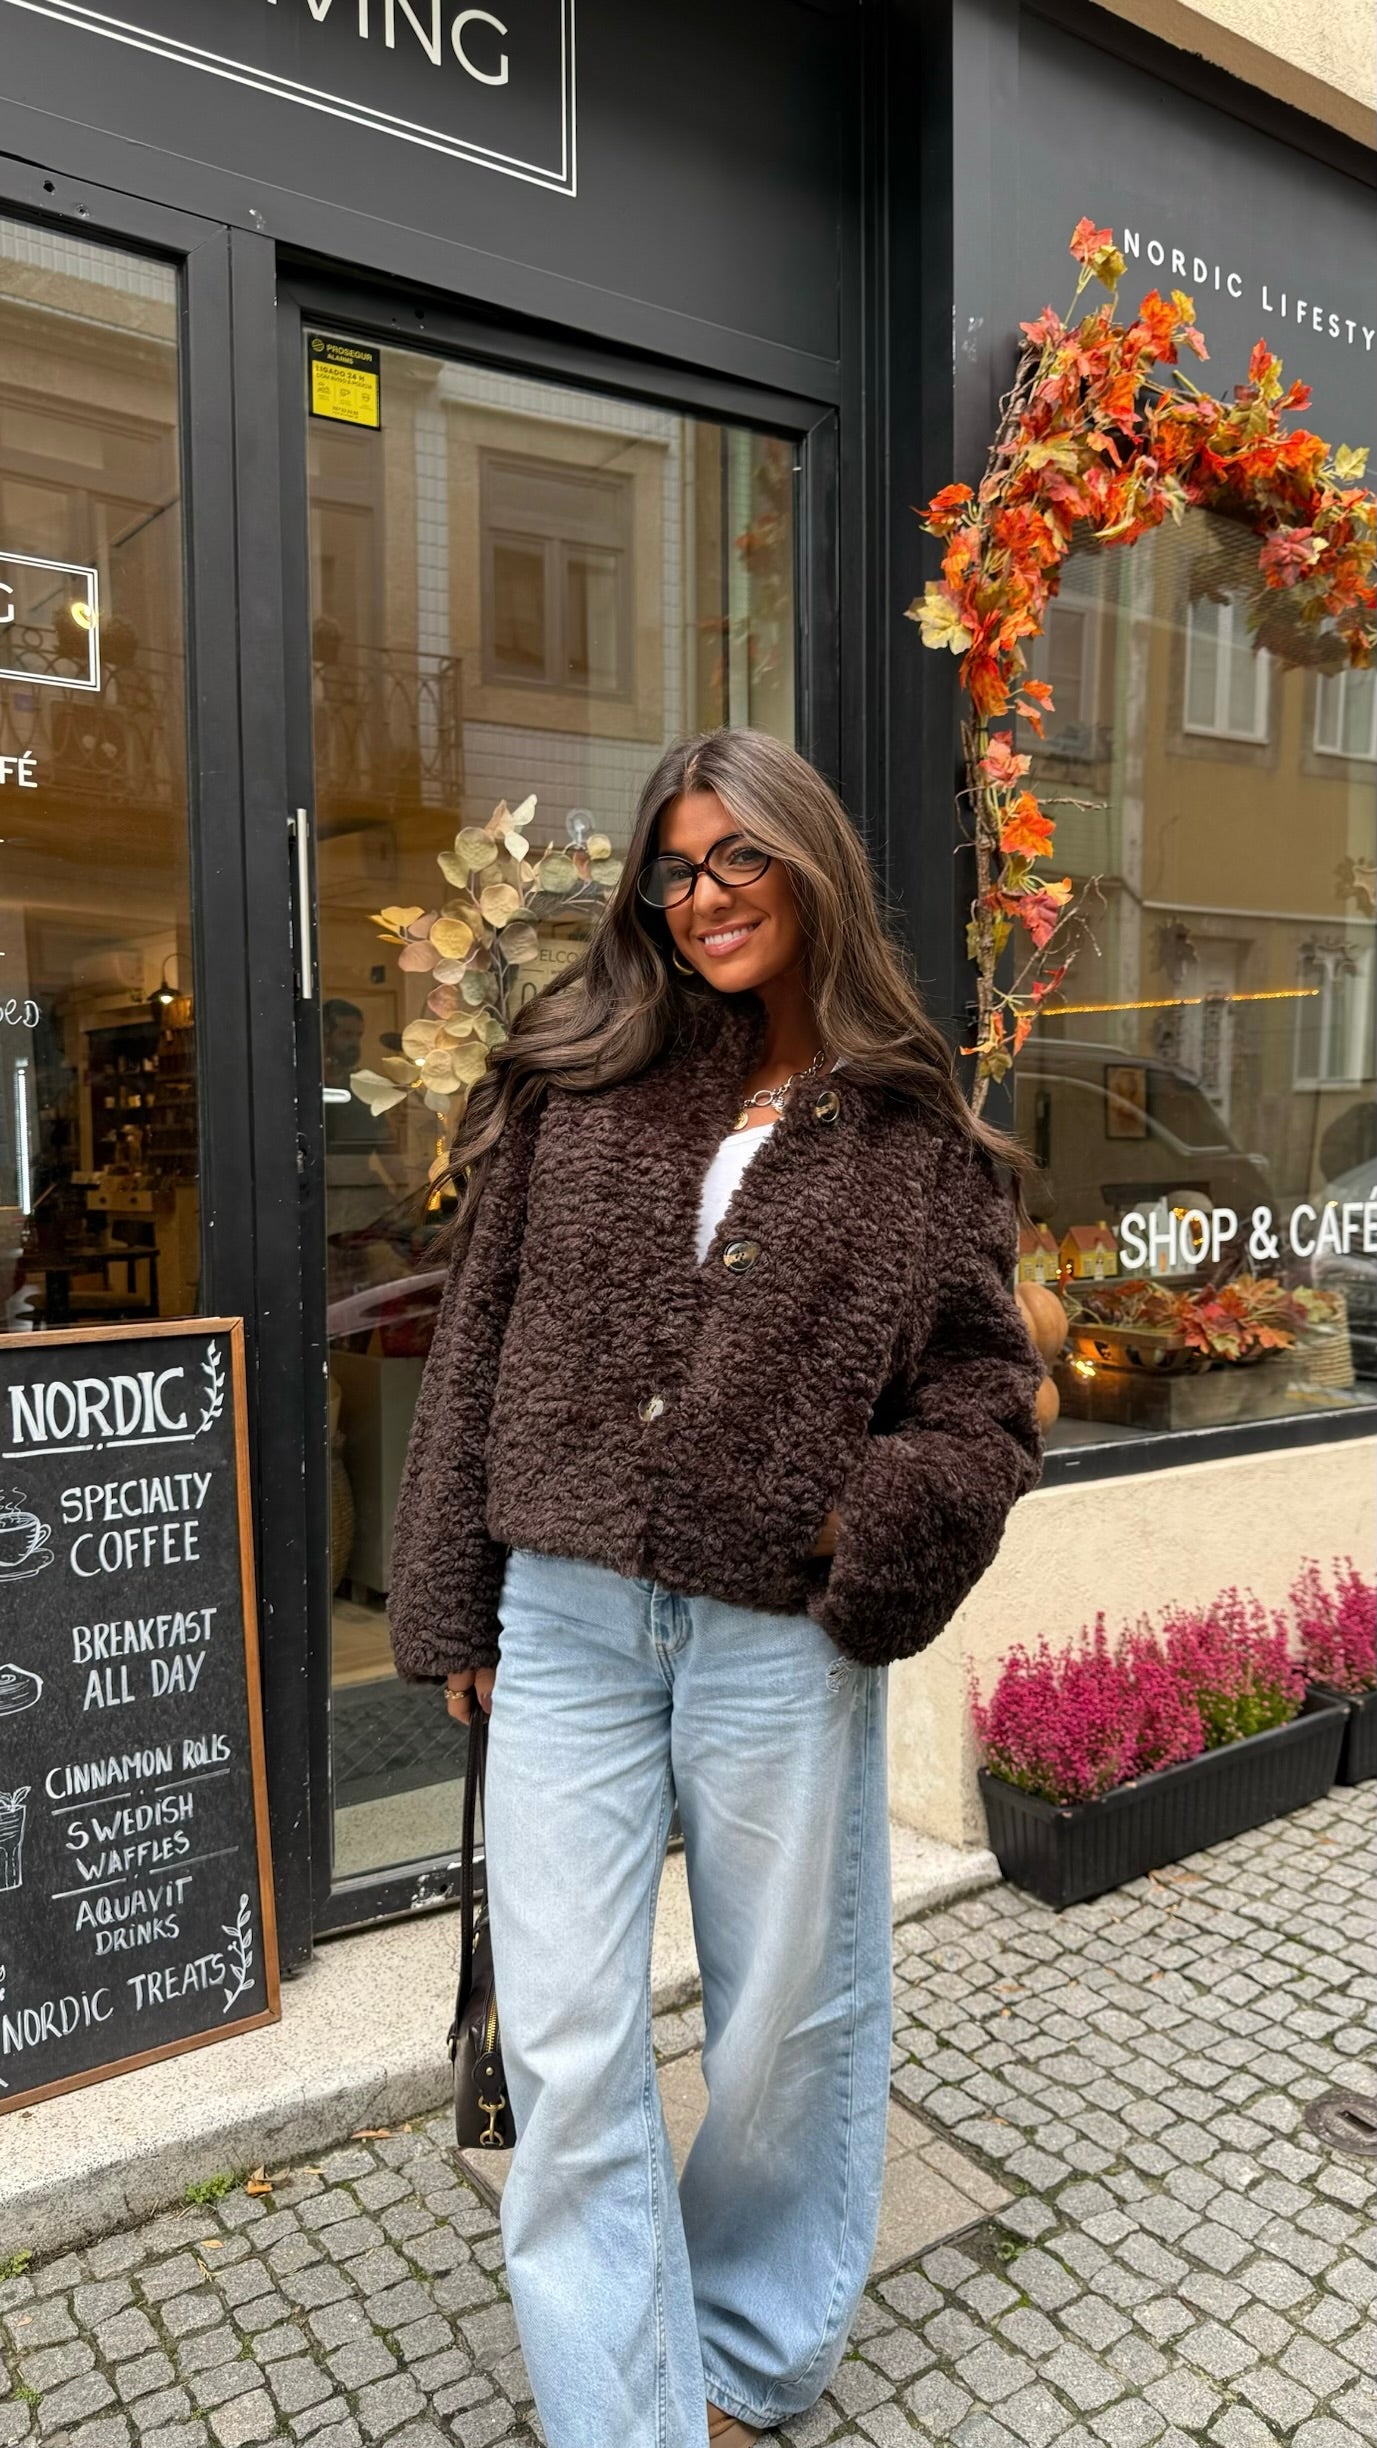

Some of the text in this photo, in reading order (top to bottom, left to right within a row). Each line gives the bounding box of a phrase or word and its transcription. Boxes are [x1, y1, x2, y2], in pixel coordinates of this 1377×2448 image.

[1124, 228, 1375, 351] NORDIC LIFESTY
[326, 343, 373, 362] PROSEGUR
[535, 948, 579, 964] ELCO
[1119, 1185, 1377, 1269] SHOP & CAFÉ
[8, 1366, 188, 1443] NORDIC
[61, 1472, 212, 1524] SPECIALTY
[70, 1520, 200, 1578] COFFEE
[72, 1607, 217, 1664] BREAKFAST
[83, 1650, 206, 1712] ALL DAY
[45, 1733, 231, 1800] CINNAMON ROLLS
[65, 1792, 194, 1850] SWEDISH
[76, 1829, 190, 1881] WAFFLES
[75, 1876, 193, 1931] AQUAVIT
[95, 1913, 180, 1956] DRINKS
[2, 1952, 226, 2055] NORDIC TREATS
